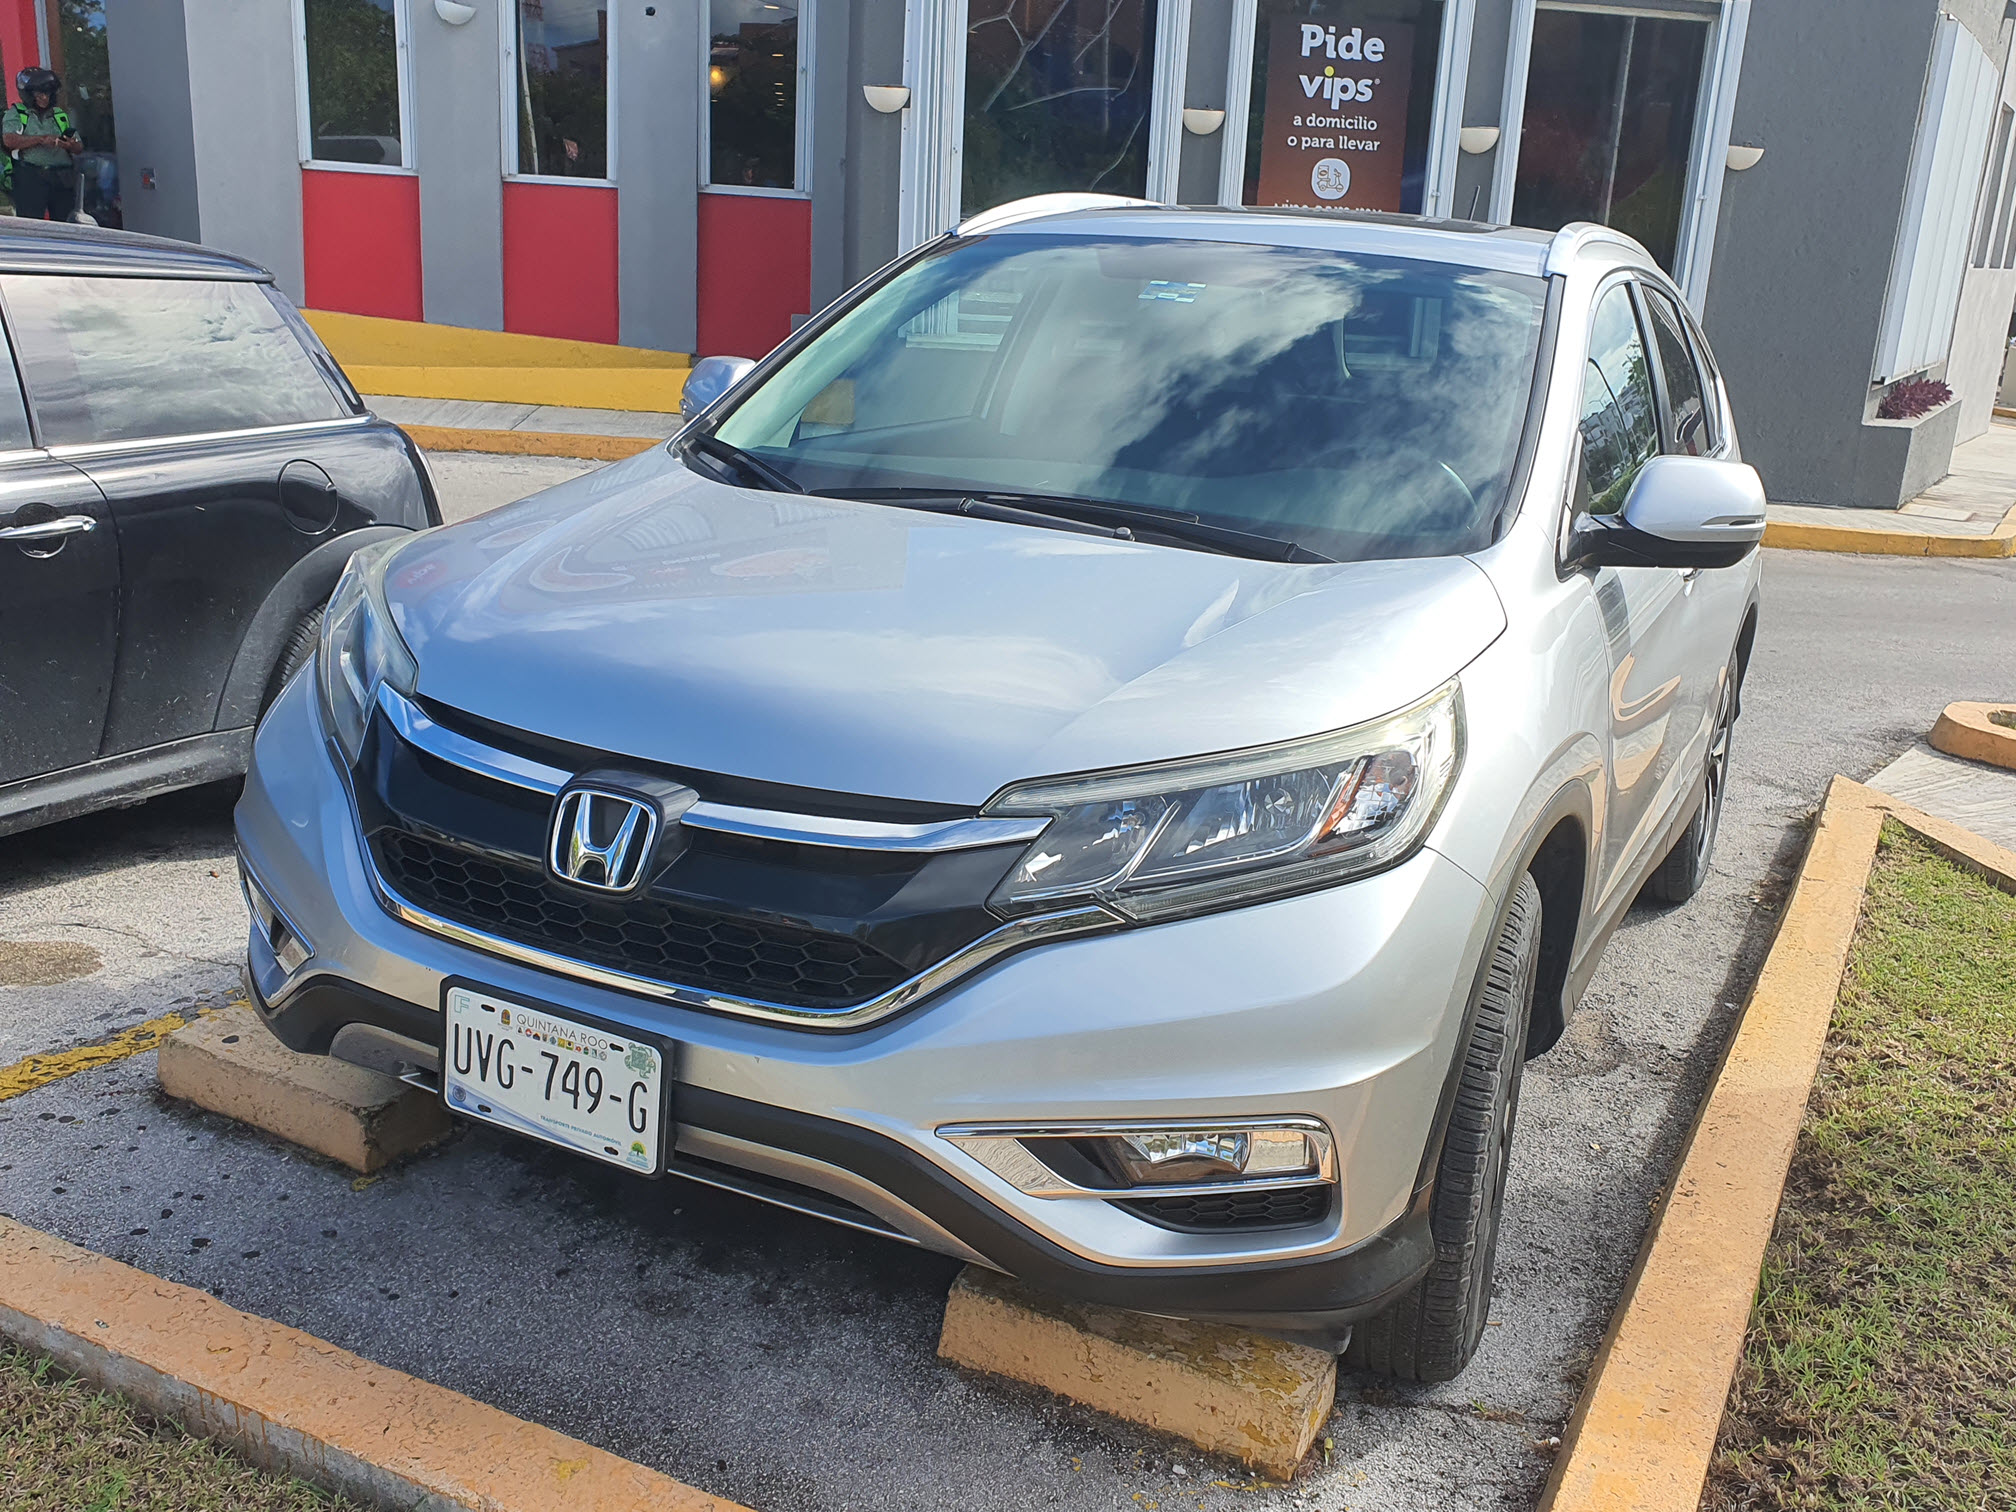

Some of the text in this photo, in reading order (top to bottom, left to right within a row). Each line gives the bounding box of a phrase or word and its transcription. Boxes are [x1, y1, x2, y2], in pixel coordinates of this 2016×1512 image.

[1300, 23, 1385, 62] Pide
[1293, 113, 1378, 131] a domicilio
[1287, 135, 1381, 151] o para llevar
[454, 994, 471, 1014] F
[516, 1013, 578, 1042] QUINTANA
[580, 1032, 609, 1051] ROO
[453, 1022, 648, 1133] UVG-749-G
[540, 1114, 622, 1147] TRANSPORTE PRIVADO AUTOMÓVIL
